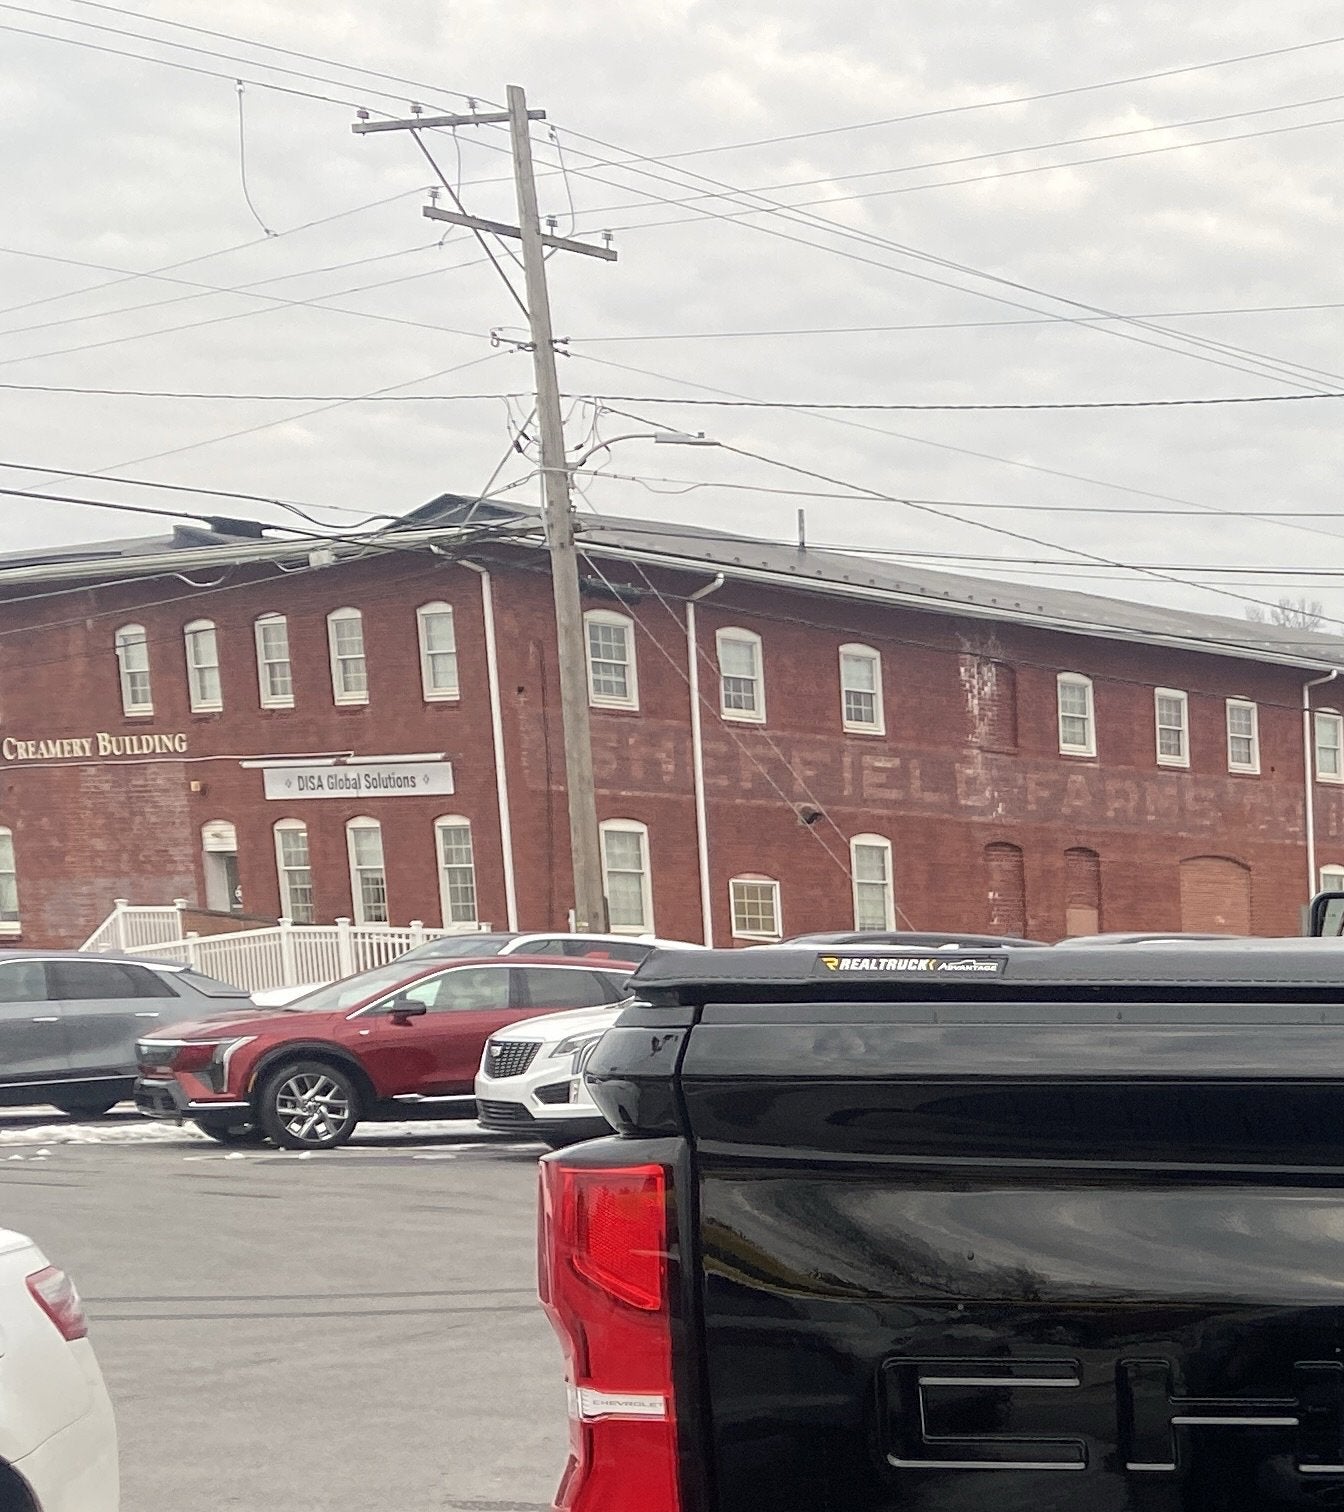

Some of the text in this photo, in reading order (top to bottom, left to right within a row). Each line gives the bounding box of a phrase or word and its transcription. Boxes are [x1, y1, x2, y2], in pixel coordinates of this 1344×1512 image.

[297, 772, 416, 791] DISA Global Solutions
[838, 958, 928, 971] REALTRUCK
[592, 1399, 662, 1408] CHEVROLET
